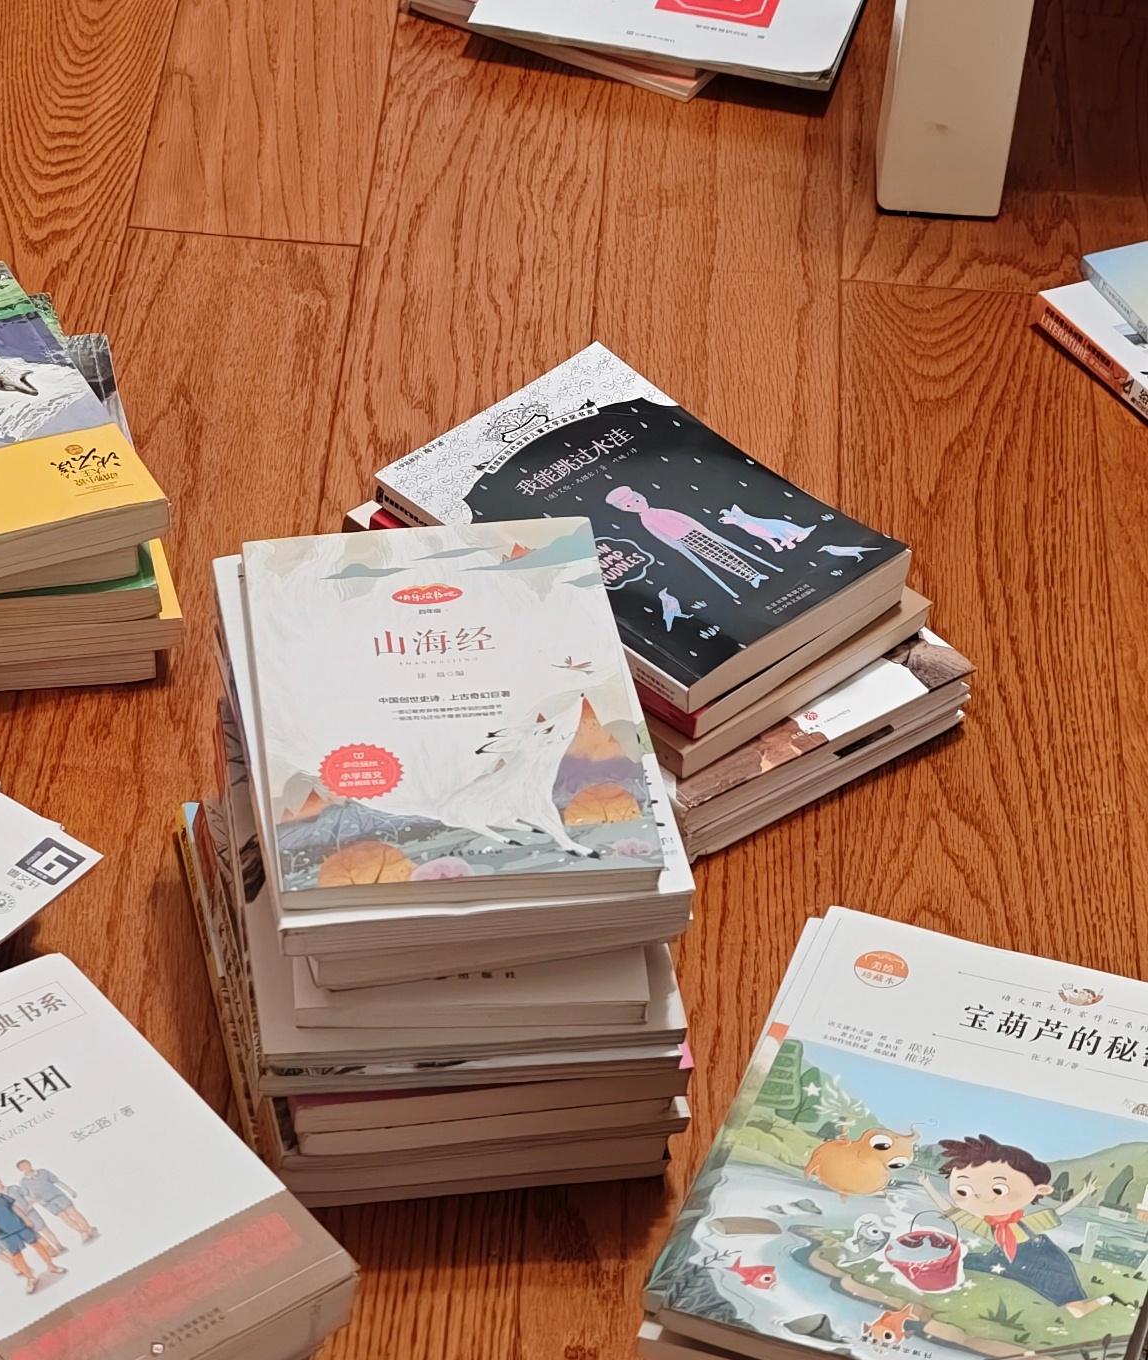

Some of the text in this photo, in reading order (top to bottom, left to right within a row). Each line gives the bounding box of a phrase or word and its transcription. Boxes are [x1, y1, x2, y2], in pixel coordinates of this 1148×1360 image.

[514, 427, 636, 496] 我能跳过水洼
[373, 626, 497, 657] 山海经
[860, 970, 896, 986] 珍藏本
[958, 1003, 1148, 1067] 宝葫芦的秘
